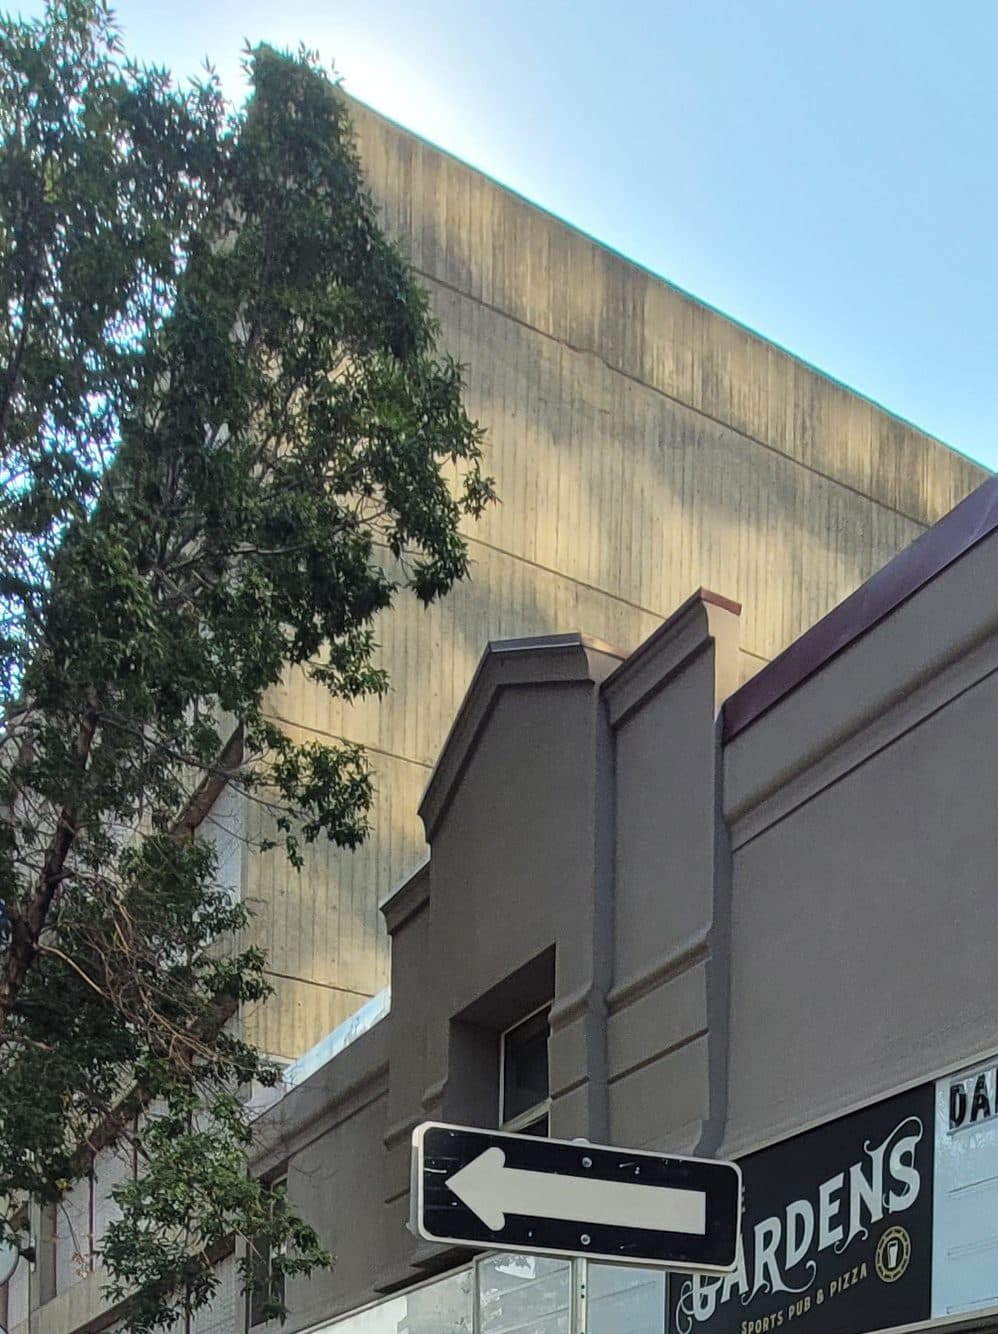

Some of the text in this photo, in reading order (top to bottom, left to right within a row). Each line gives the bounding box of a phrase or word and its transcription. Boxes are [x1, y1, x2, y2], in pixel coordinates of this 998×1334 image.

[788, 1296, 812, 1321] PUB
[816, 1287, 825, 1305] &
[830, 1262, 868, 1298] PIZZA
